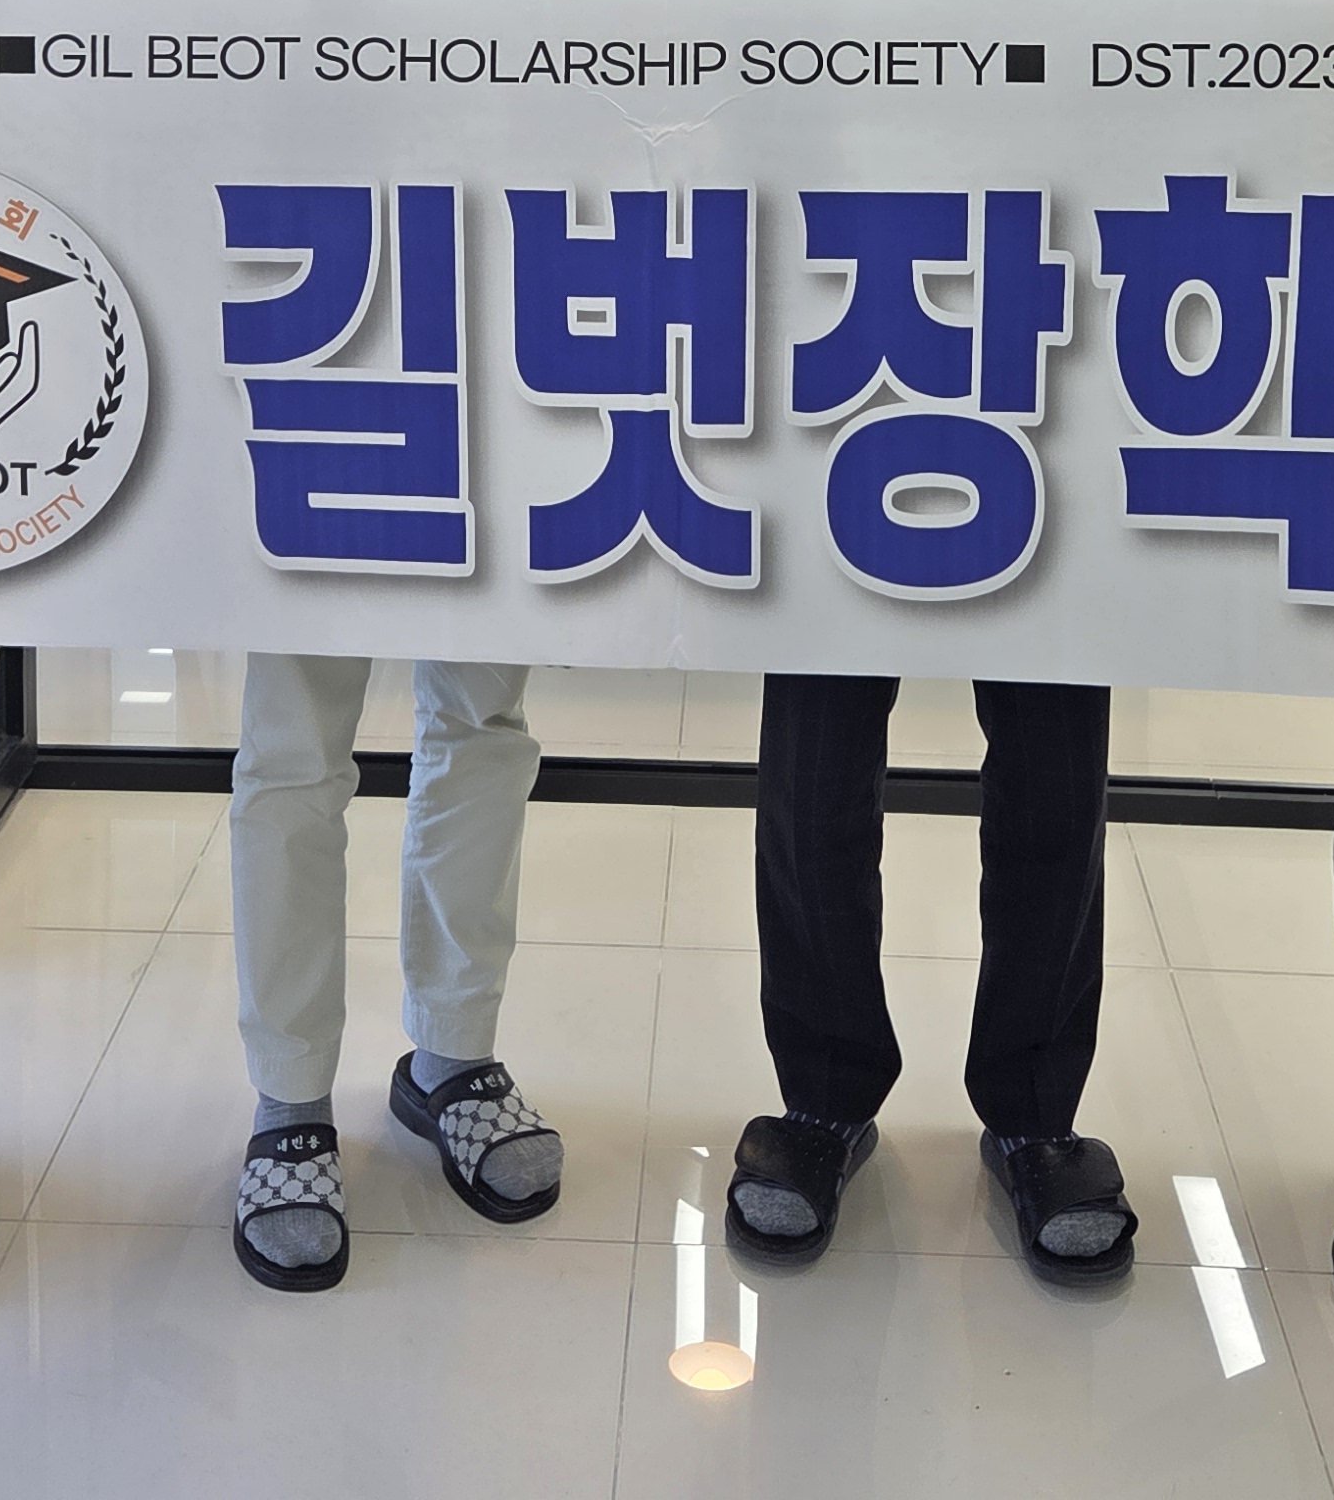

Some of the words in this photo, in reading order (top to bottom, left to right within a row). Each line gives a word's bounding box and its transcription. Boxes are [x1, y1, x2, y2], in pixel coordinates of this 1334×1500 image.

[41, 33, 134, 79] GIL
[147, 34, 302, 81] BEOT
[313, 36, 728, 87] SCHOLARSHIP
[739, 39, 1001, 86] SOCIETY
